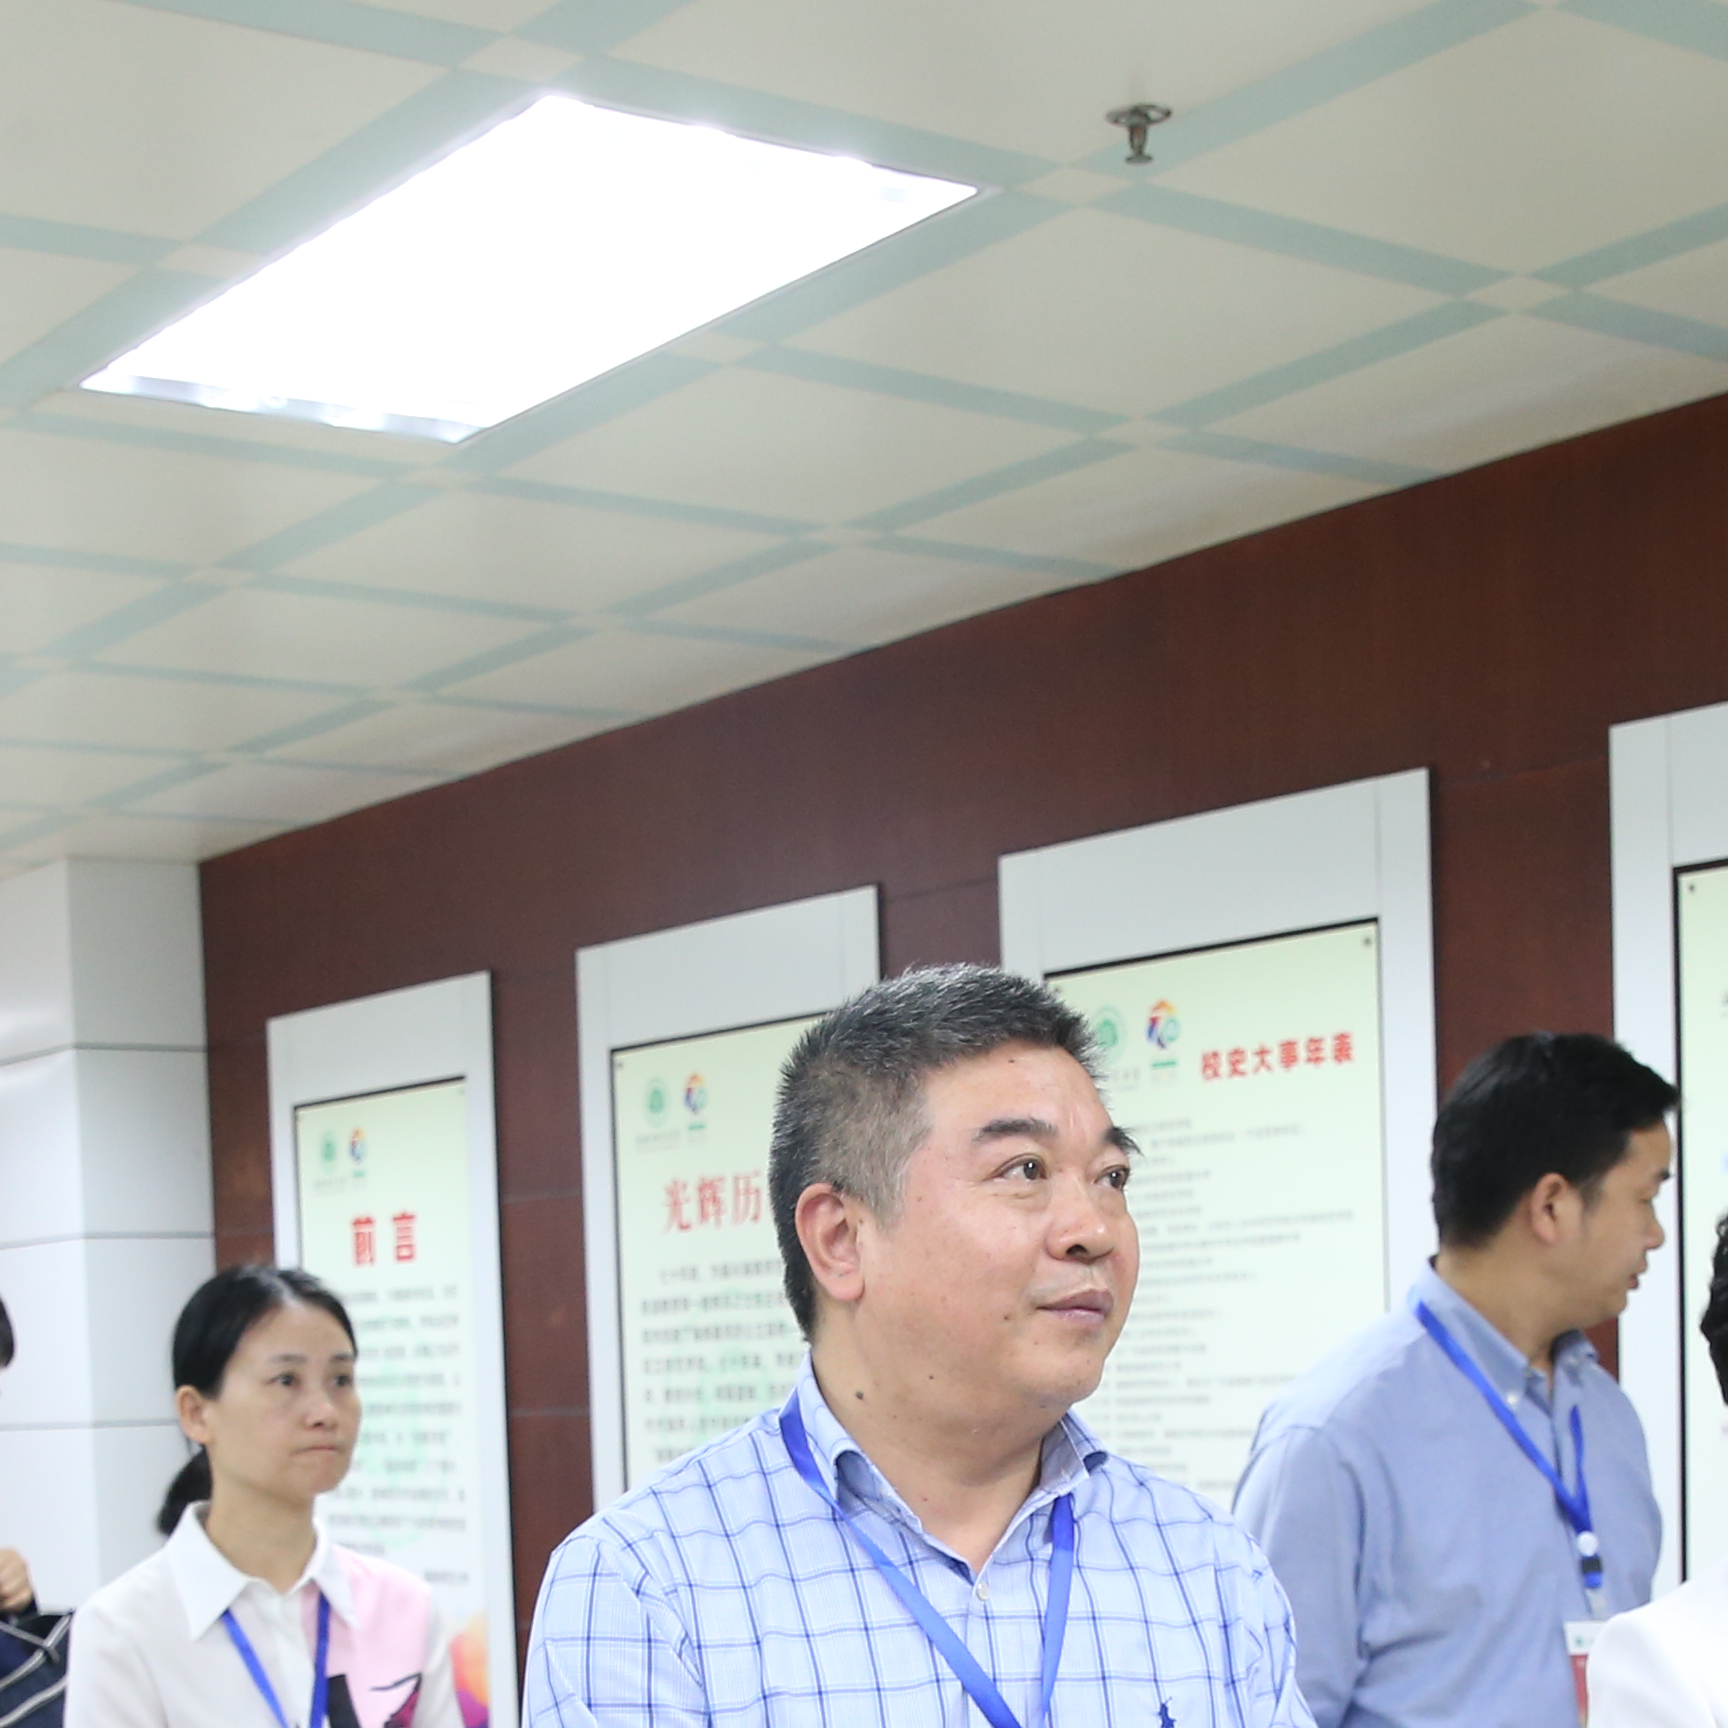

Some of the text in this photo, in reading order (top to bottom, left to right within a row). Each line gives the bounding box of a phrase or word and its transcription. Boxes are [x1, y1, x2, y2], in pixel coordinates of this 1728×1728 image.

[1201, 1031, 1355, 1082] 校史大事年表
[351, 1211, 418, 1266] 前言
